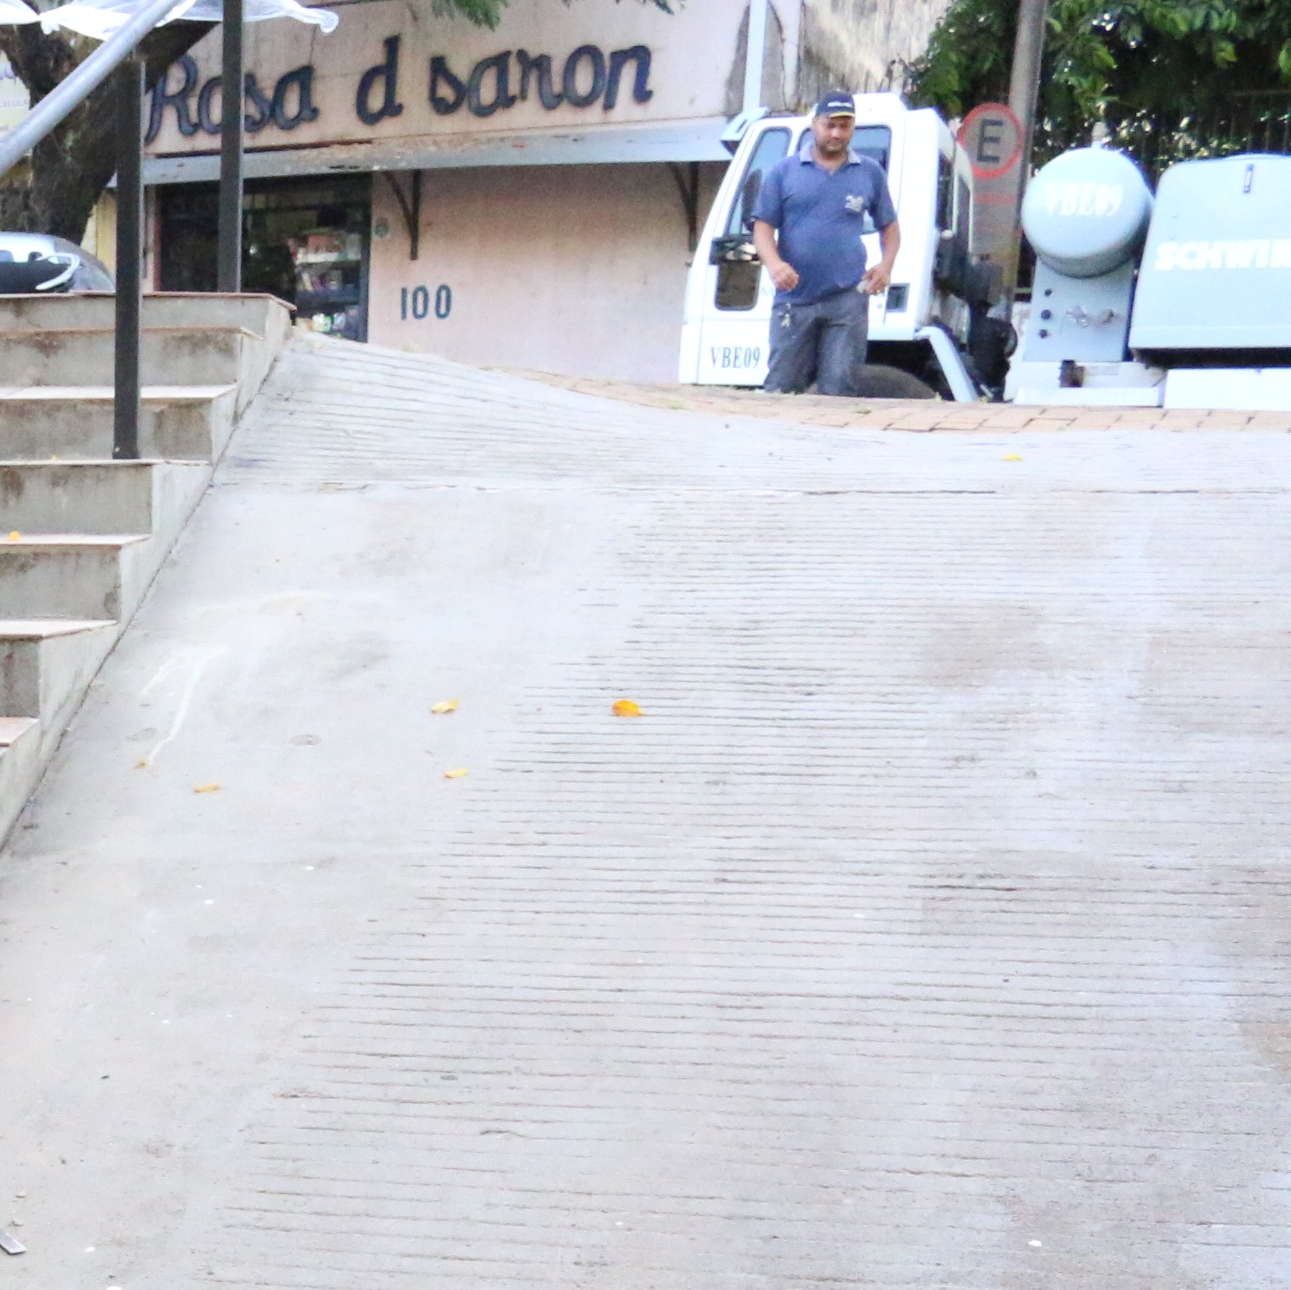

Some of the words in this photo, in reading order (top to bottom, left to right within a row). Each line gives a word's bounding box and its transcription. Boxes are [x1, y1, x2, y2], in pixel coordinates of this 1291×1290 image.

[144, 53, 320, 146] Rosa
[355, 34, 403, 126] d
[976, 118, 1004, 163] E
[1045, 181, 1124, 218] VBE09
[400, 284, 453, 321] 100
[710, 345, 762, 369] VBE09
